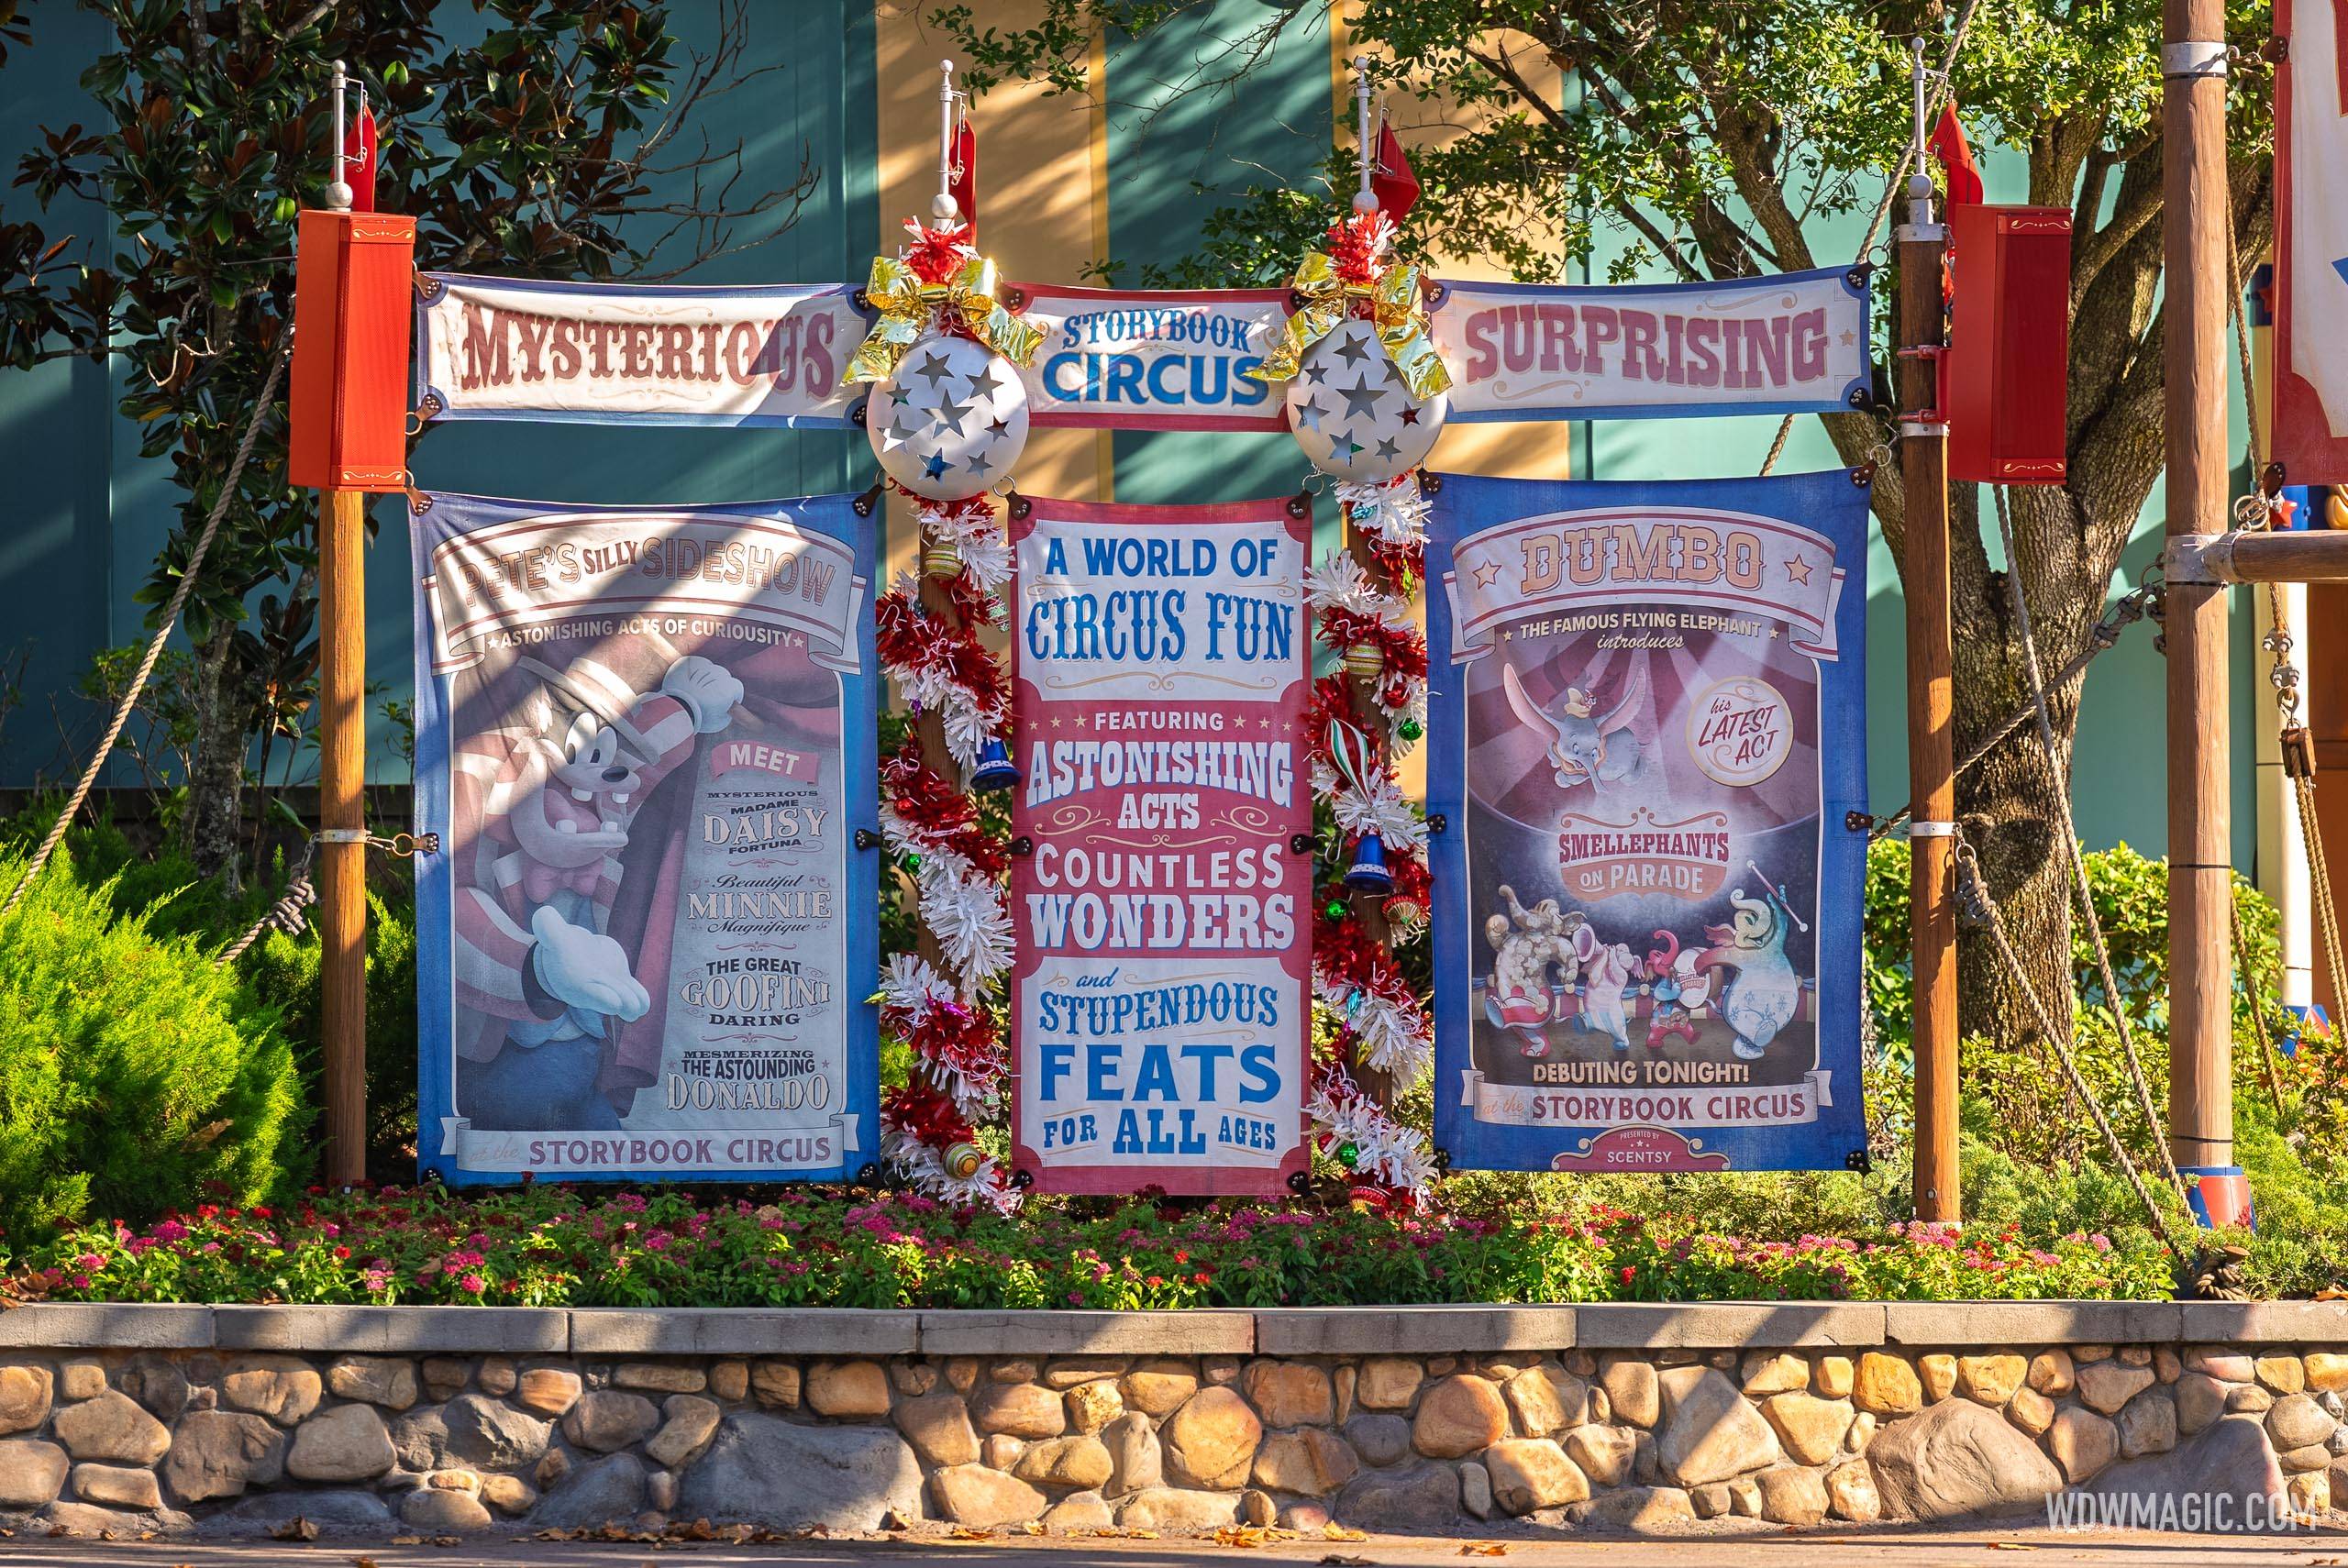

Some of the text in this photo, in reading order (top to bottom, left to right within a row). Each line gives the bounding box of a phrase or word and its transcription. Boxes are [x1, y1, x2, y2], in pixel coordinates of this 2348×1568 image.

[1062, 309, 1252, 353] STORYBOOK
[1466, 304, 1829, 390] SURPRISING
[461, 303, 835, 401] MYSTERIOUS
[1043, 352, 1269, 407] CIRCUS
[459, 536, 836, 608] PETE'S SILLY SIDESHOW
[1045, 537, 1279, 578] A WORLD OF
[1520, 524, 1766, 595] DUMBO
[500, 618, 792, 649] ASTONISHING ACTS OF CURIOUSITY
[1025, 589, 1294, 662] CIRCUS FUN
[1520, 613, 1762, 639] THE FAMOUS FLYING ELEPHANT
[1597, 631, 1684, 649] introduces
[1710, 697, 1733, 714] his
[1095, 712, 1224, 732] FEATURING
[1698, 704, 1778, 747] LATEST
[730, 744, 800, 775] MEET
[1734, 729, 1779, 766] ACT
[1025, 740, 1293, 809] ASTONISHING
[730, 800, 799, 815] MADAME
[1117, 793, 1200, 829] ACTS
[703, 807, 828, 845] DAISY
[728, 838, 803, 855] FORTUNA
[1559, 832, 1730, 864] SMELLEPHANTS
[1035, 843, 1284, 889] COUNTLESS
[1579, 864, 1703, 894] ON PARADE
[712, 874, 804, 891] Beautiful
[687, 890, 833, 920] MINNIE
[1025, 892, 1295, 950] WONDERS
[707, 920, 810, 936] Magnifique
[705, 957, 802, 977] THE GREAT
[1076, 966, 1119, 988] and
[680, 973, 831, 1012] GOOFINI
[708, 1013, 801, 1027] DARING
[1039, 982, 1279, 1036] STUPENDOUS
[681, 1059, 815, 1081] THE ASTOUNDING
[683, 1050, 815, 1059] MESMERIZING
[1039, 1044, 1281, 1103] FEATS
[1533, 1061, 1750, 1084] DEBUTING TONIGHT!
[666, 1071, 830, 1111] DONALDO
[1503, 1089, 1524, 1113] the
[1532, 1096, 1695, 1121] STORYBOOK
[1707, 1092, 1806, 1120] CIRCUS
[1044, 1109, 1276, 1154] FOR ALL AGES
[1620, 1130, 1660, 1141] PRESENTED BY
[529, 1139, 714, 1165] STORYBOOK
[726, 1137, 832, 1164] CIRCUS
[1607, 1151, 1672, 1163] SCENTSY
